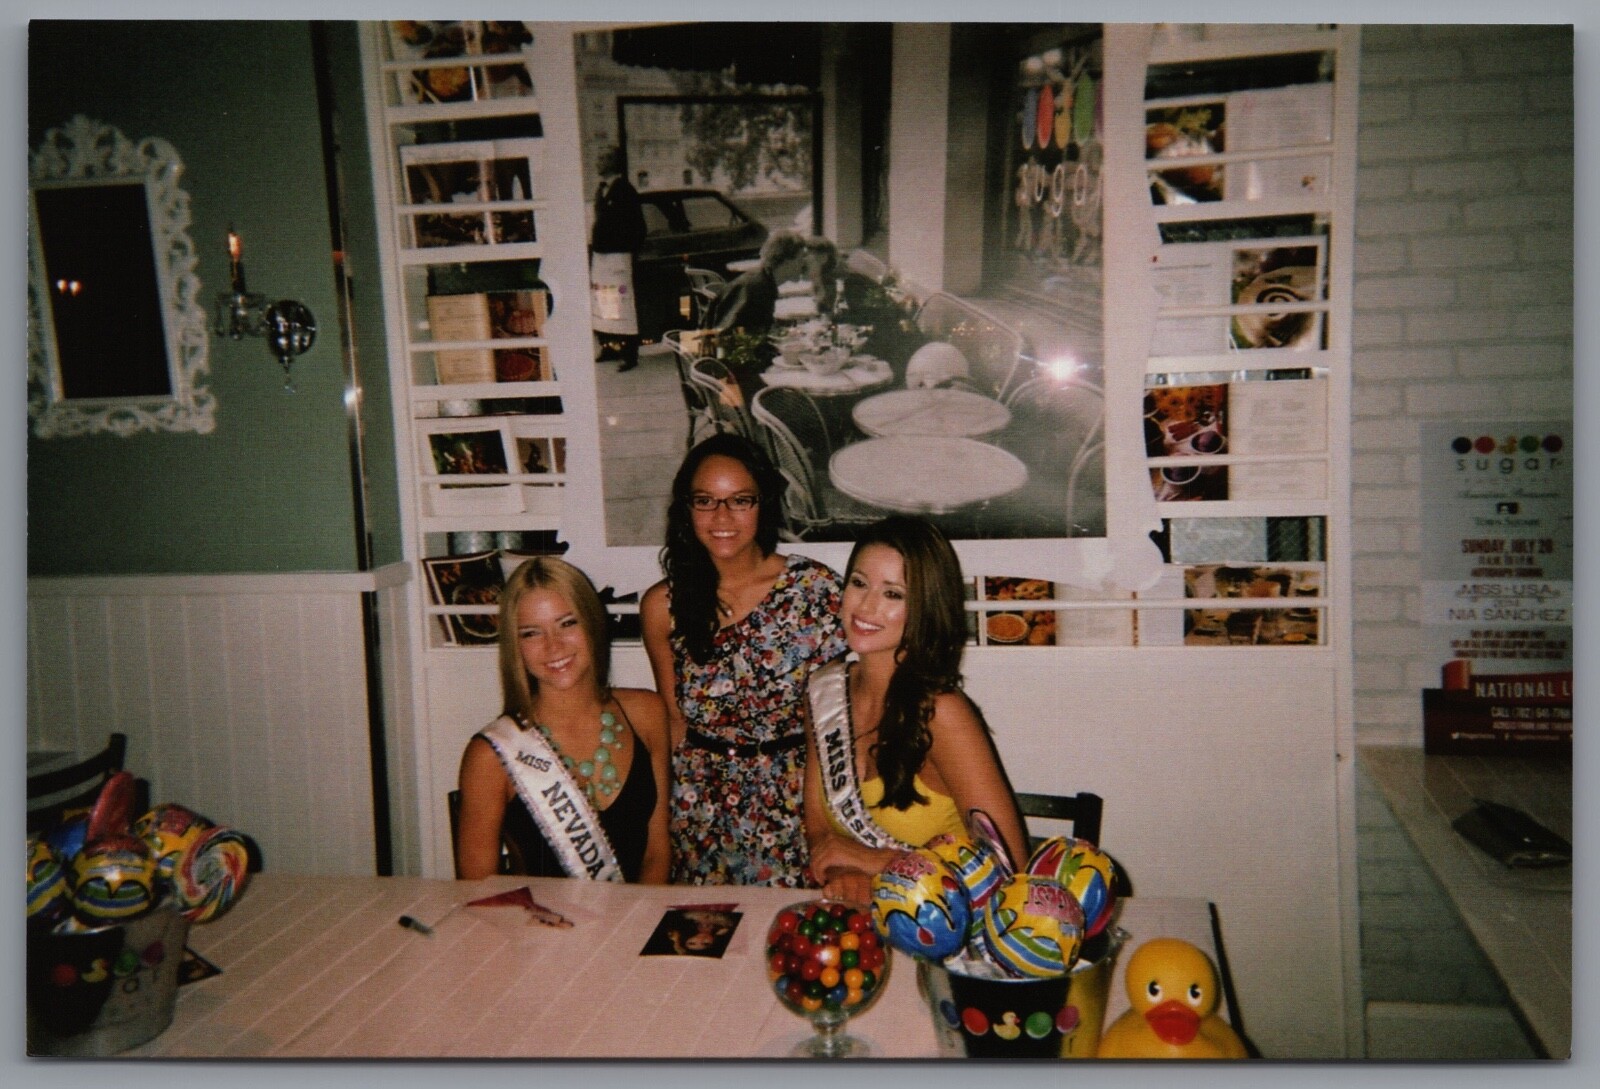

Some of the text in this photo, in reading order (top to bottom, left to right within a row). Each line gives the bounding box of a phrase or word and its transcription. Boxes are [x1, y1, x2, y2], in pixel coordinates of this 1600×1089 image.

[1456, 458, 1560, 475] sugar
[1511, 583, 1553, 596] USA
[1448, 608, 1567, 622] NIA SANCHEZ
[1475, 682, 1555, 698] NATIONAL
[825, 728, 879, 848] MISS USA
[515, 750, 605, 880] MISS NEVADA
